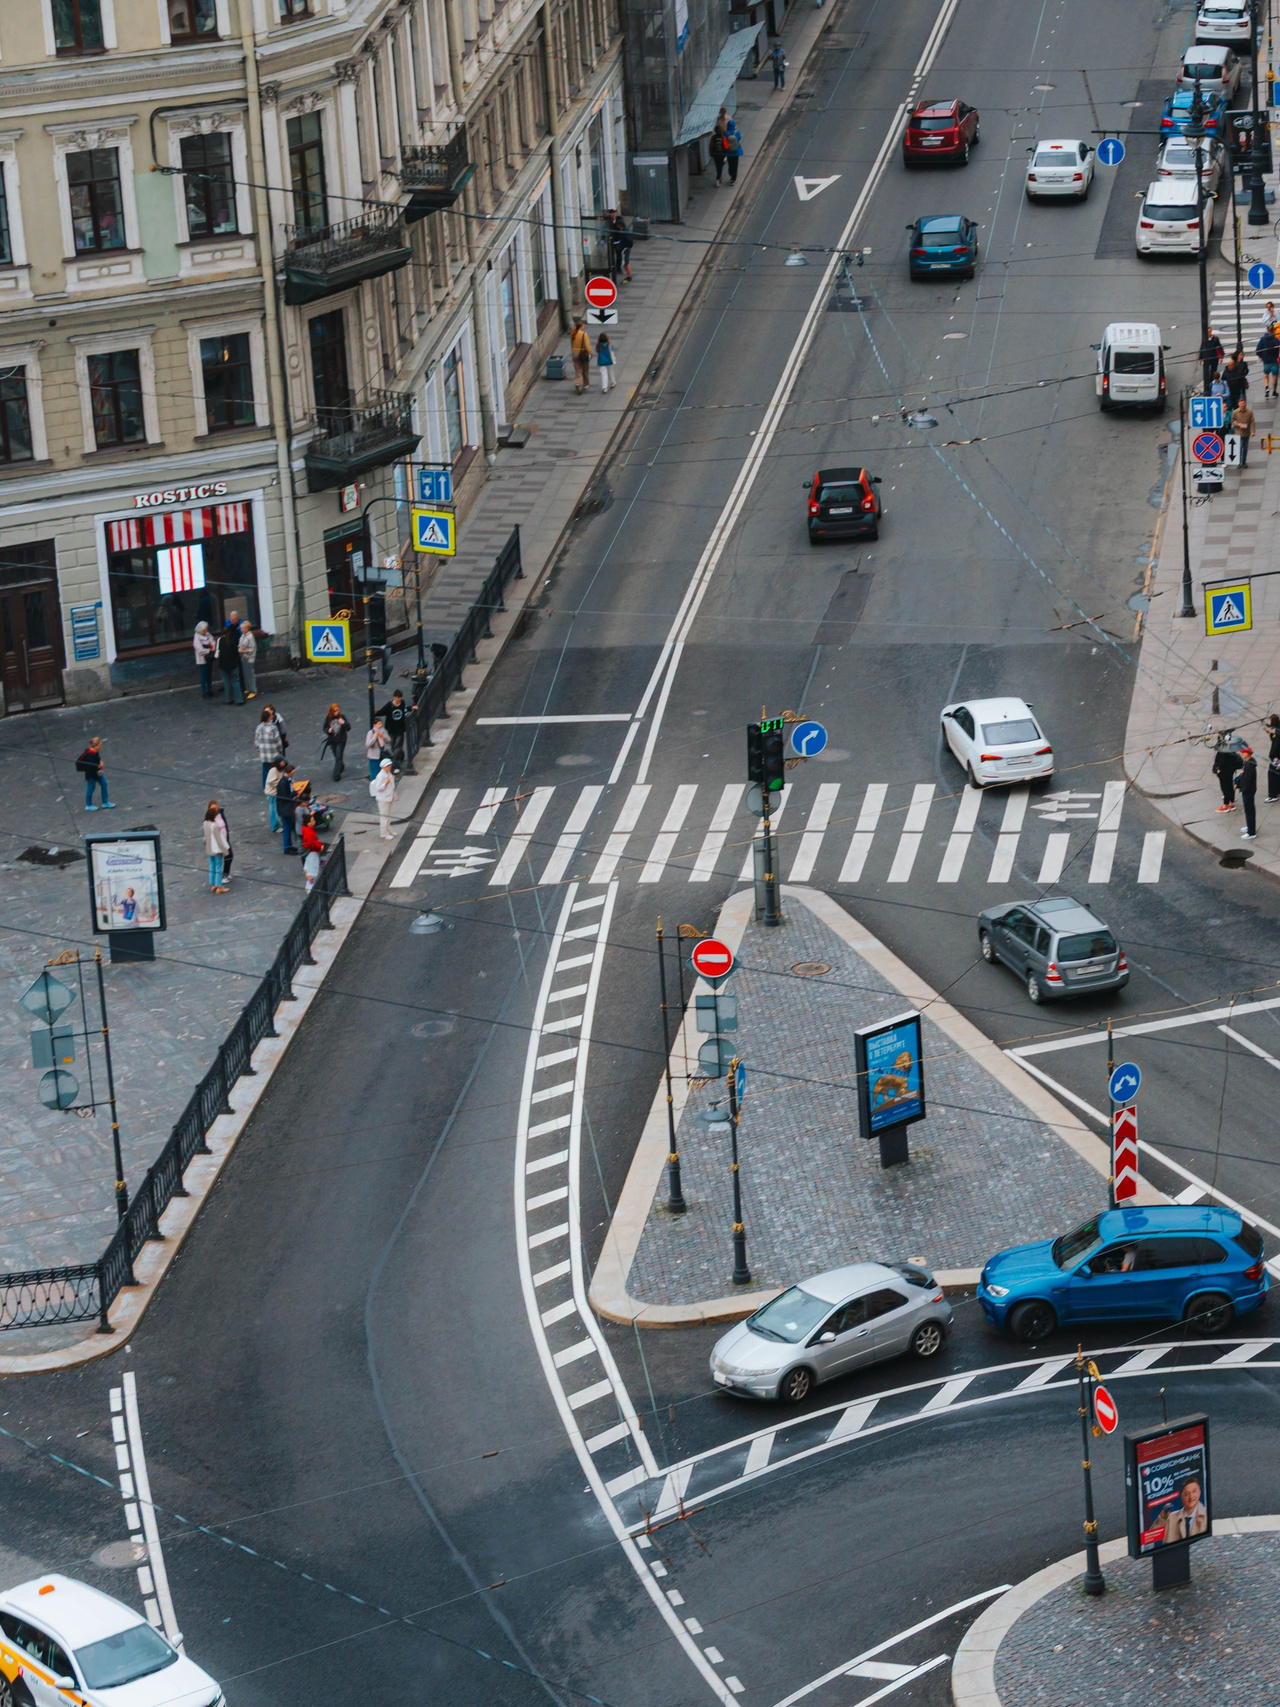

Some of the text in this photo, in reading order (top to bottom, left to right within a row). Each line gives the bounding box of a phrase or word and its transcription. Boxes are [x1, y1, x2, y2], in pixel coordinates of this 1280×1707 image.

[134, 482, 228, 508] ROSTIC'S
[1150, 1452, 1201, 1473] СОВКОМБАНК
[1143, 1474, 1174, 1496] 10%
